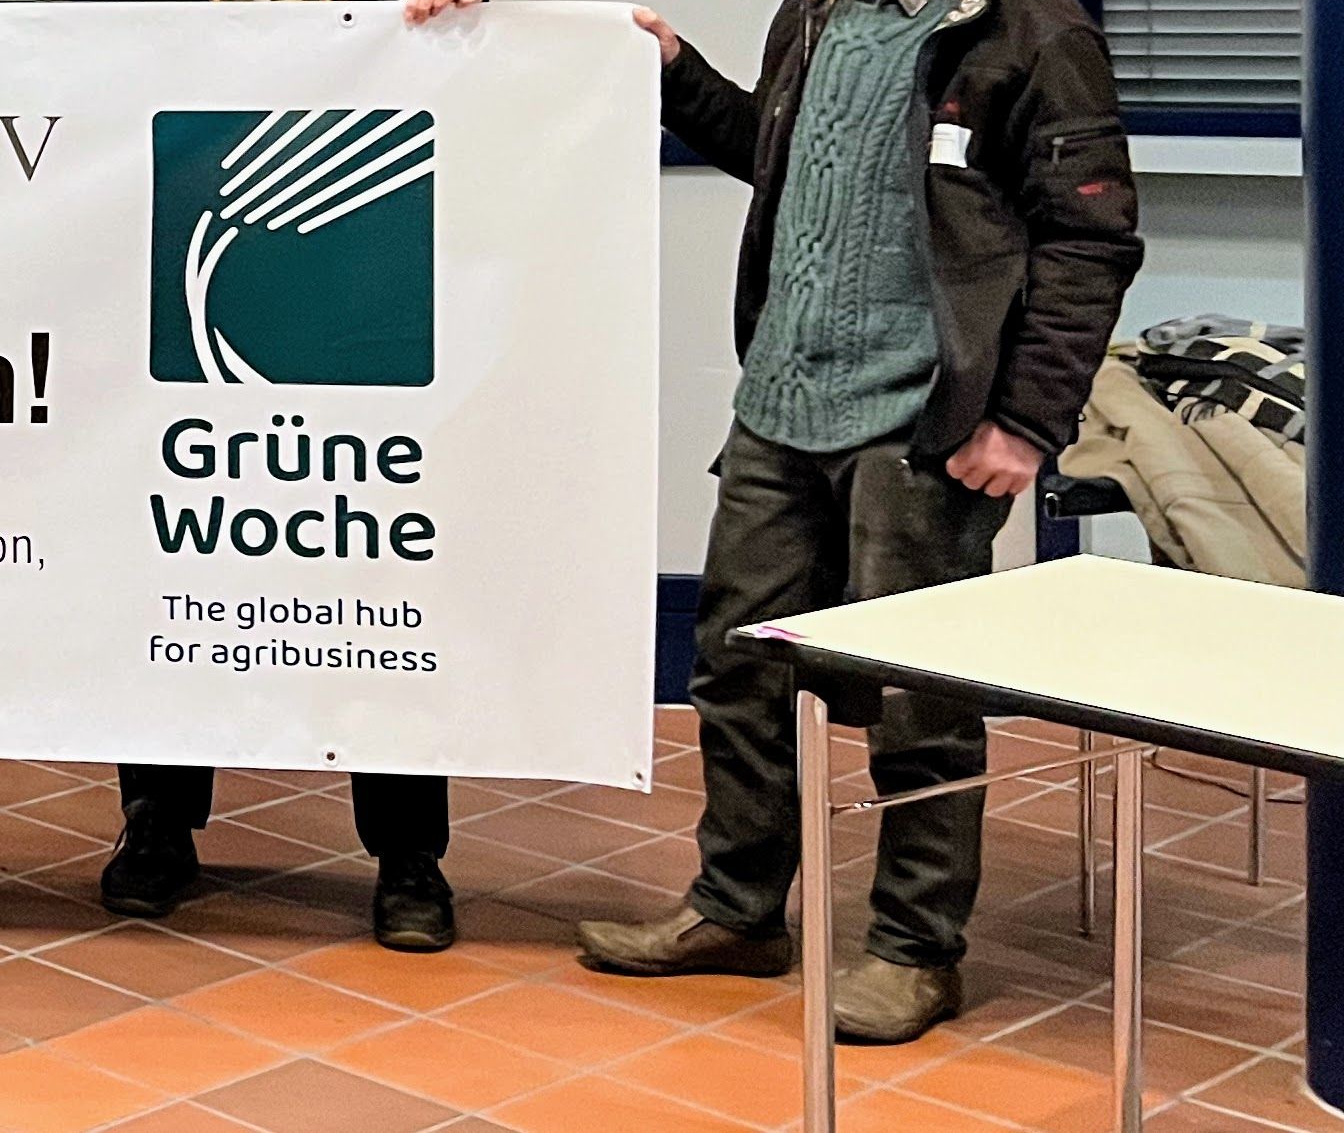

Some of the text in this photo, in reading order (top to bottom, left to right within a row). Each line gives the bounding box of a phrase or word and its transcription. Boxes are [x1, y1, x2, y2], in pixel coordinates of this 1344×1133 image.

[161, 414, 423, 484] Grüne
[149, 494, 436, 562] Woche
[162, 594, 423, 630] The global hub
[150, 635, 438, 672] for agribusiness
